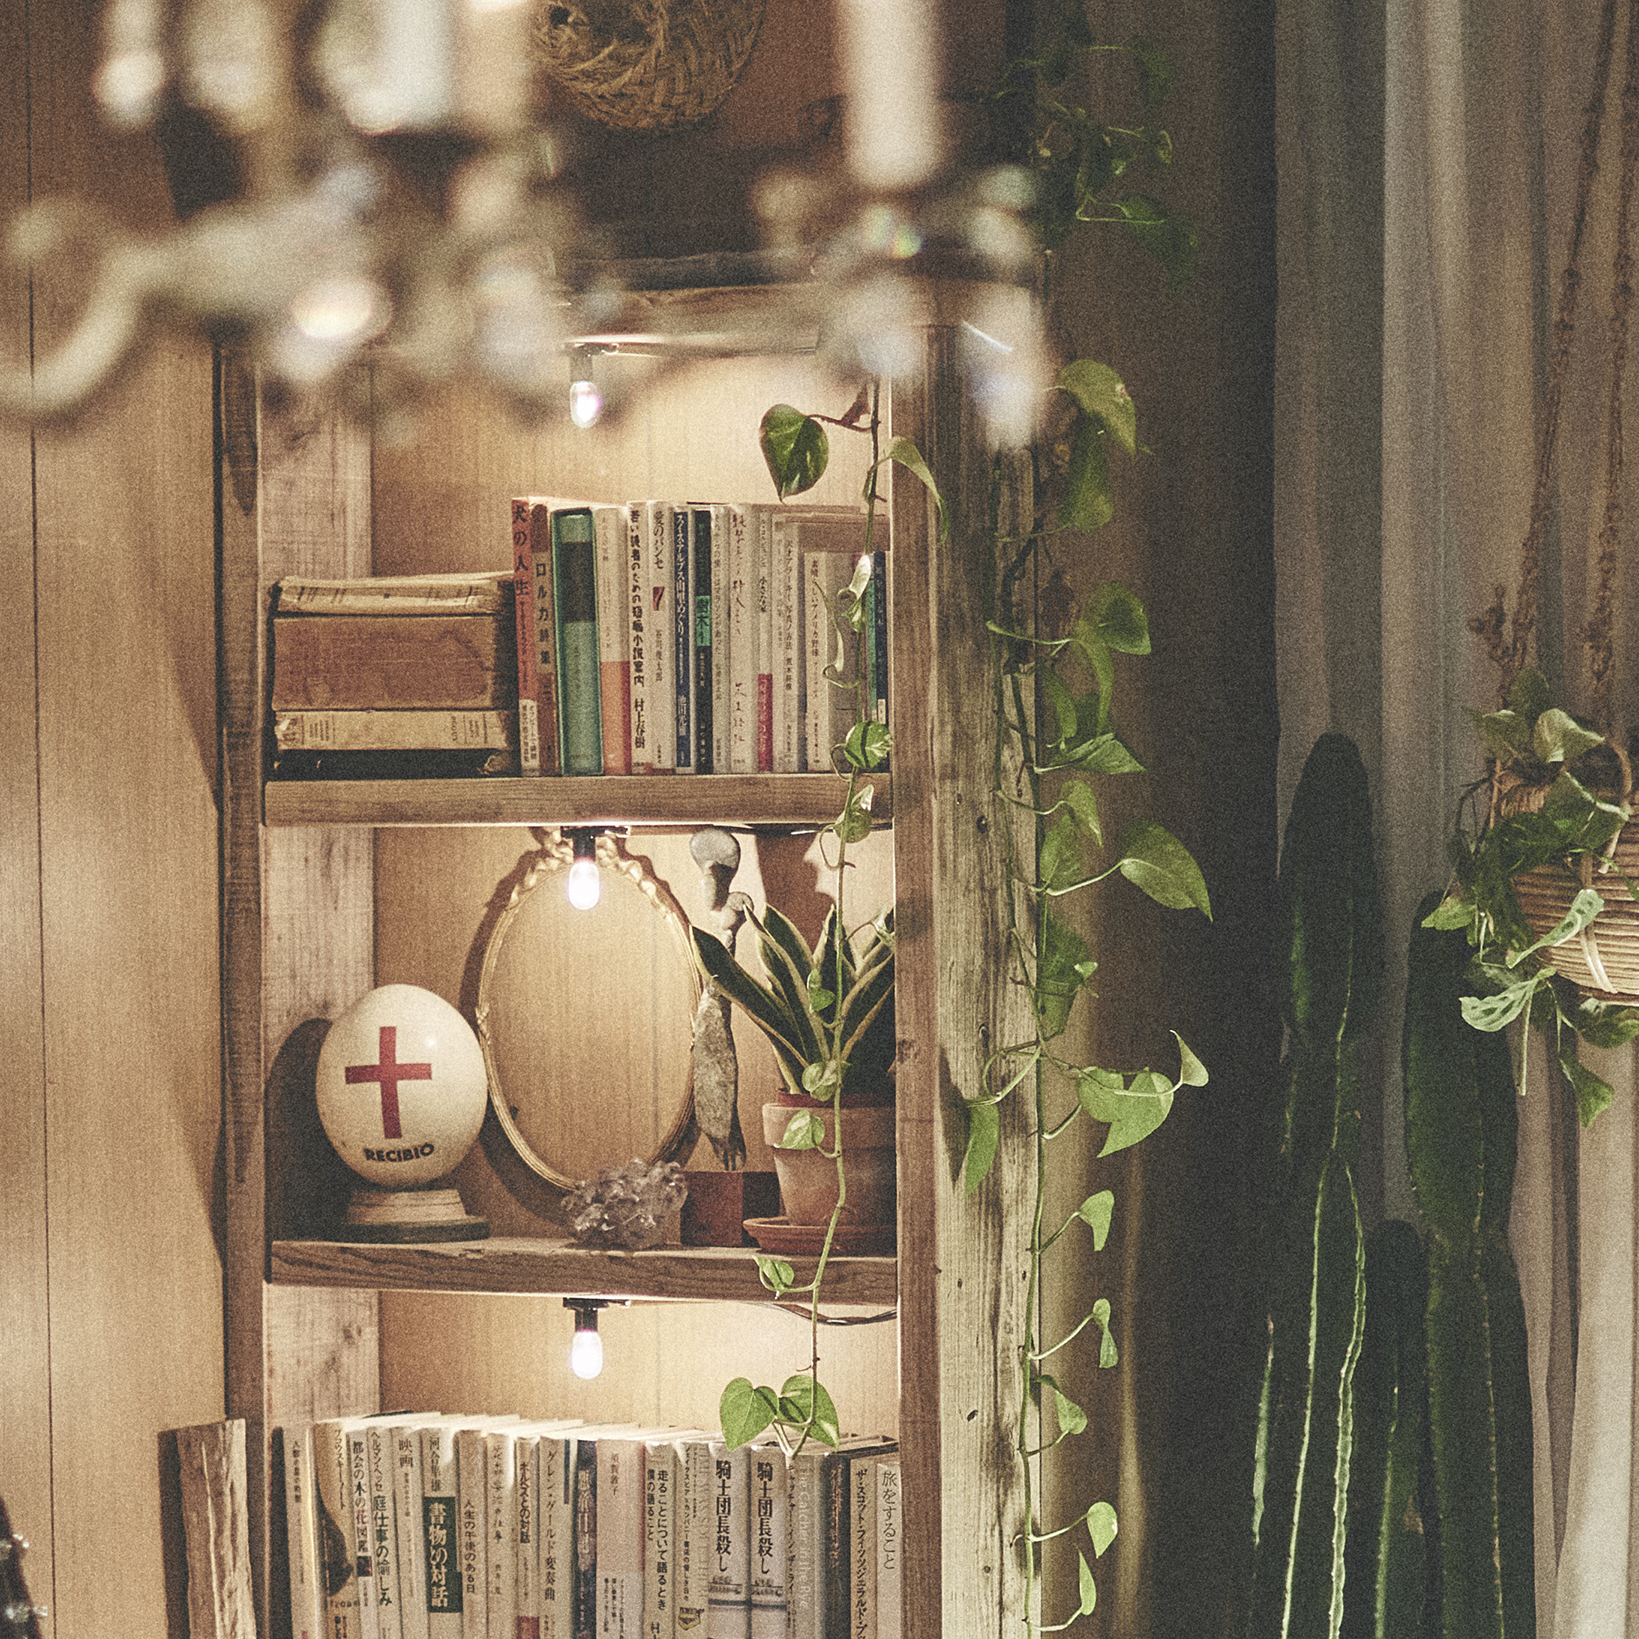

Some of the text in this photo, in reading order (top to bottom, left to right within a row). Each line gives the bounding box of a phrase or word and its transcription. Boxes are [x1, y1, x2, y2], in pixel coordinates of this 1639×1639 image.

[512, 505, 530, 597] 犬の人生
[634, 698, 645, 749] 村上春樹
[398, 1438, 413, 1469] 映画
[428, 1437, 442, 1492] 河合隼雄
[374, 1495, 393, 1607] 庭仕事の愉しみ
[428, 1502, 449, 1608] 書物との対話
[464, 1498, 476, 1594] 人生の午後のある日
[545, 1450, 557, 1601] グレン・グールド変奏曲
[647, 1469, 656, 1542] 僕の語ること
[656, 1470, 669, 1611] 走ることについて語るとき
[716, 1460, 732, 1572] 騎士団長殺し
[757, 1462, 773, 1574] 騎士団長殺し
[881, 1470, 897, 1570] 旅をすること
